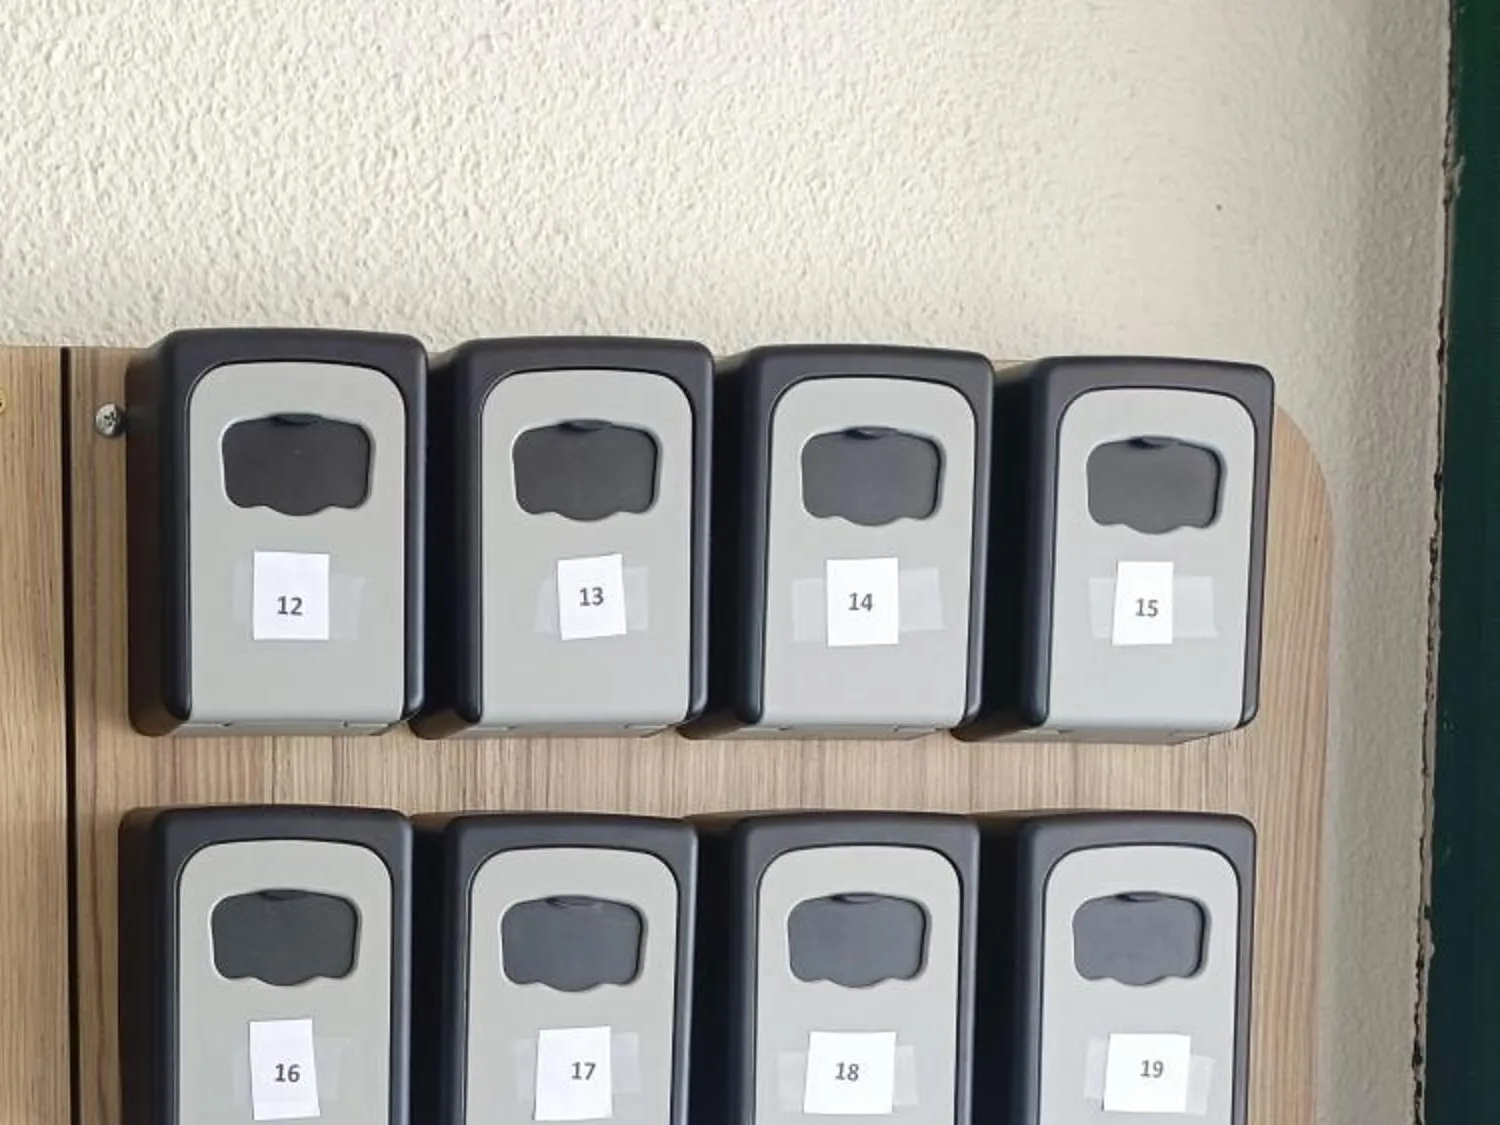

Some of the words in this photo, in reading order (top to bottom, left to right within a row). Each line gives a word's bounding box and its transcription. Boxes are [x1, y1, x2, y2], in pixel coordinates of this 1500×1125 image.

[277, 596, 303, 616] 12
[579, 586, 604, 607] 13
[849, 592, 873, 612] 14
[1136, 598, 1159, 618] 15
[275, 1063, 301, 1083] 16
[572, 1061, 596, 1080] 17
[835, 1062, 859, 1082] 18
[1140, 1059, 1164, 1079] 19
